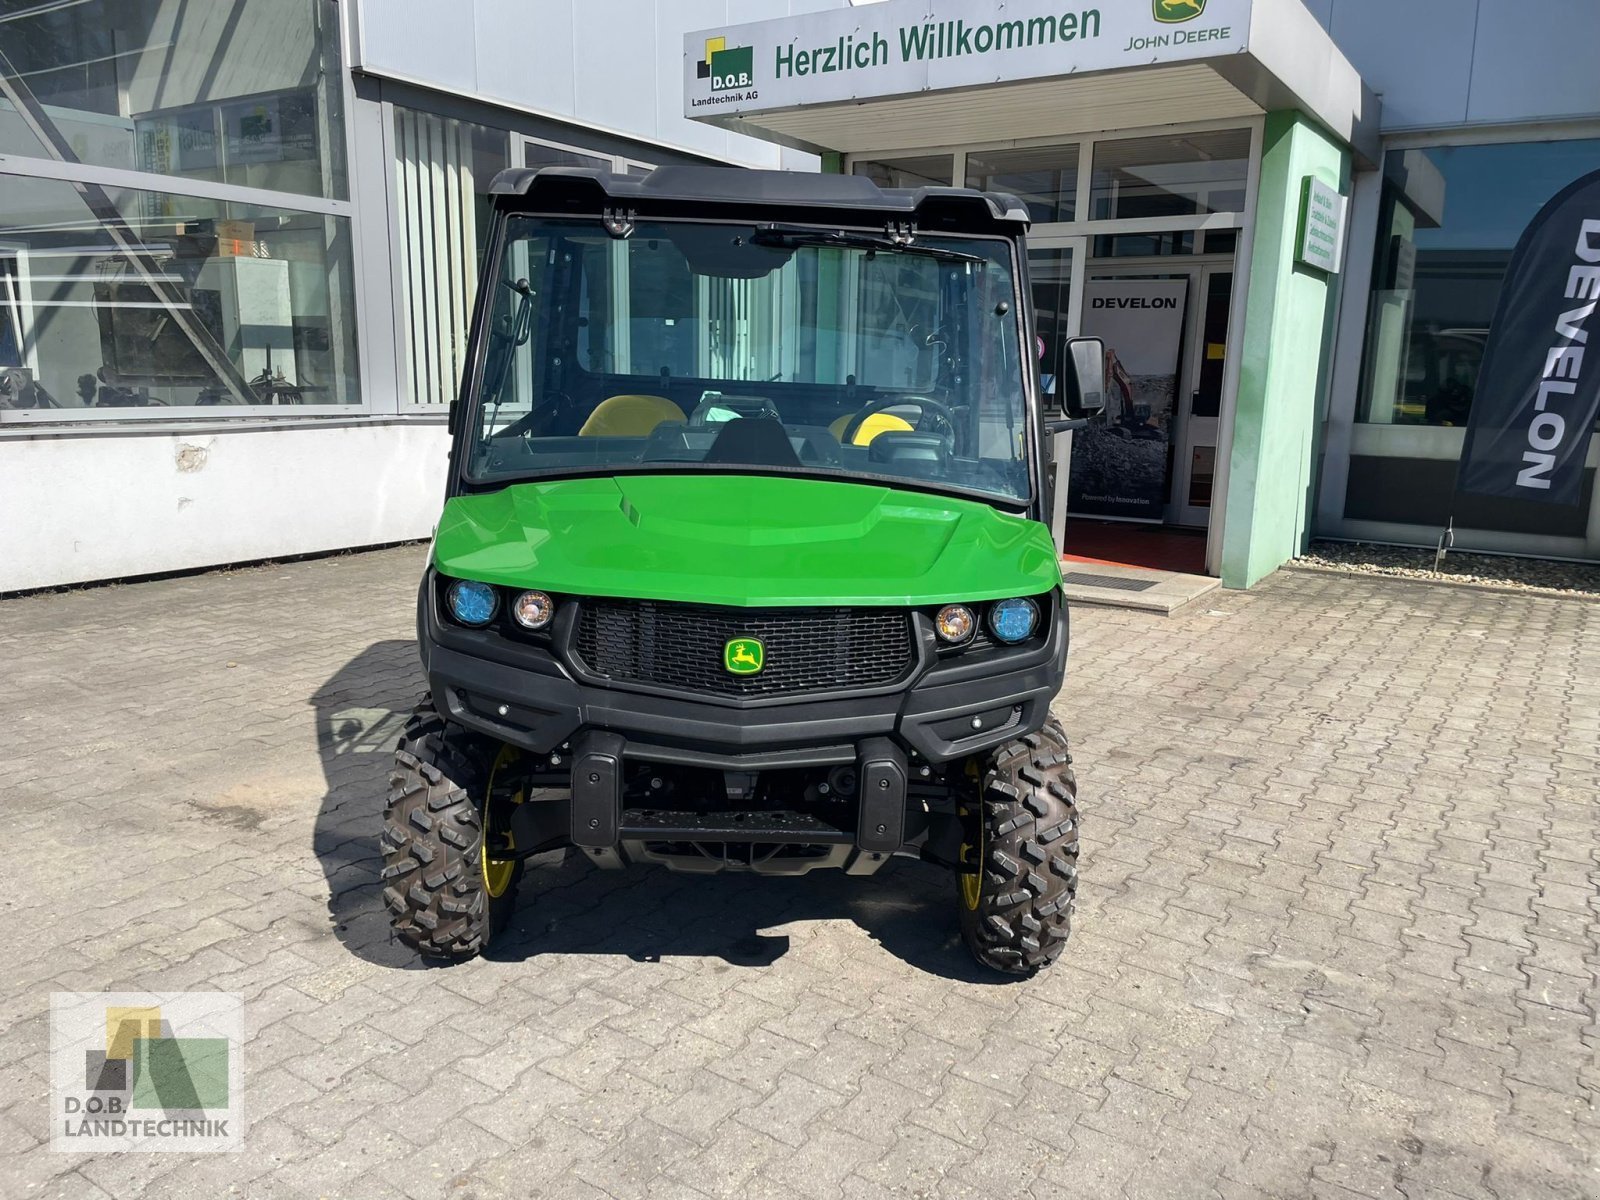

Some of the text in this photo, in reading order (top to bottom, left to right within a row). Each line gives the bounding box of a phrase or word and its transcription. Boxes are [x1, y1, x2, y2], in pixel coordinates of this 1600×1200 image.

[775, 8, 1101, 79] Herzlich Willkommen
[1123, 26, 1231, 51] JOHN DEERE
[712, 72, 752, 89] D.O.B.
[692, 91, 758, 106] Landtechnik AG
[1092, 297, 1177, 309] DEVELON
[1515, 218, 1600, 489] DEVELON
[1116, 495, 1150, 505] Innovation
